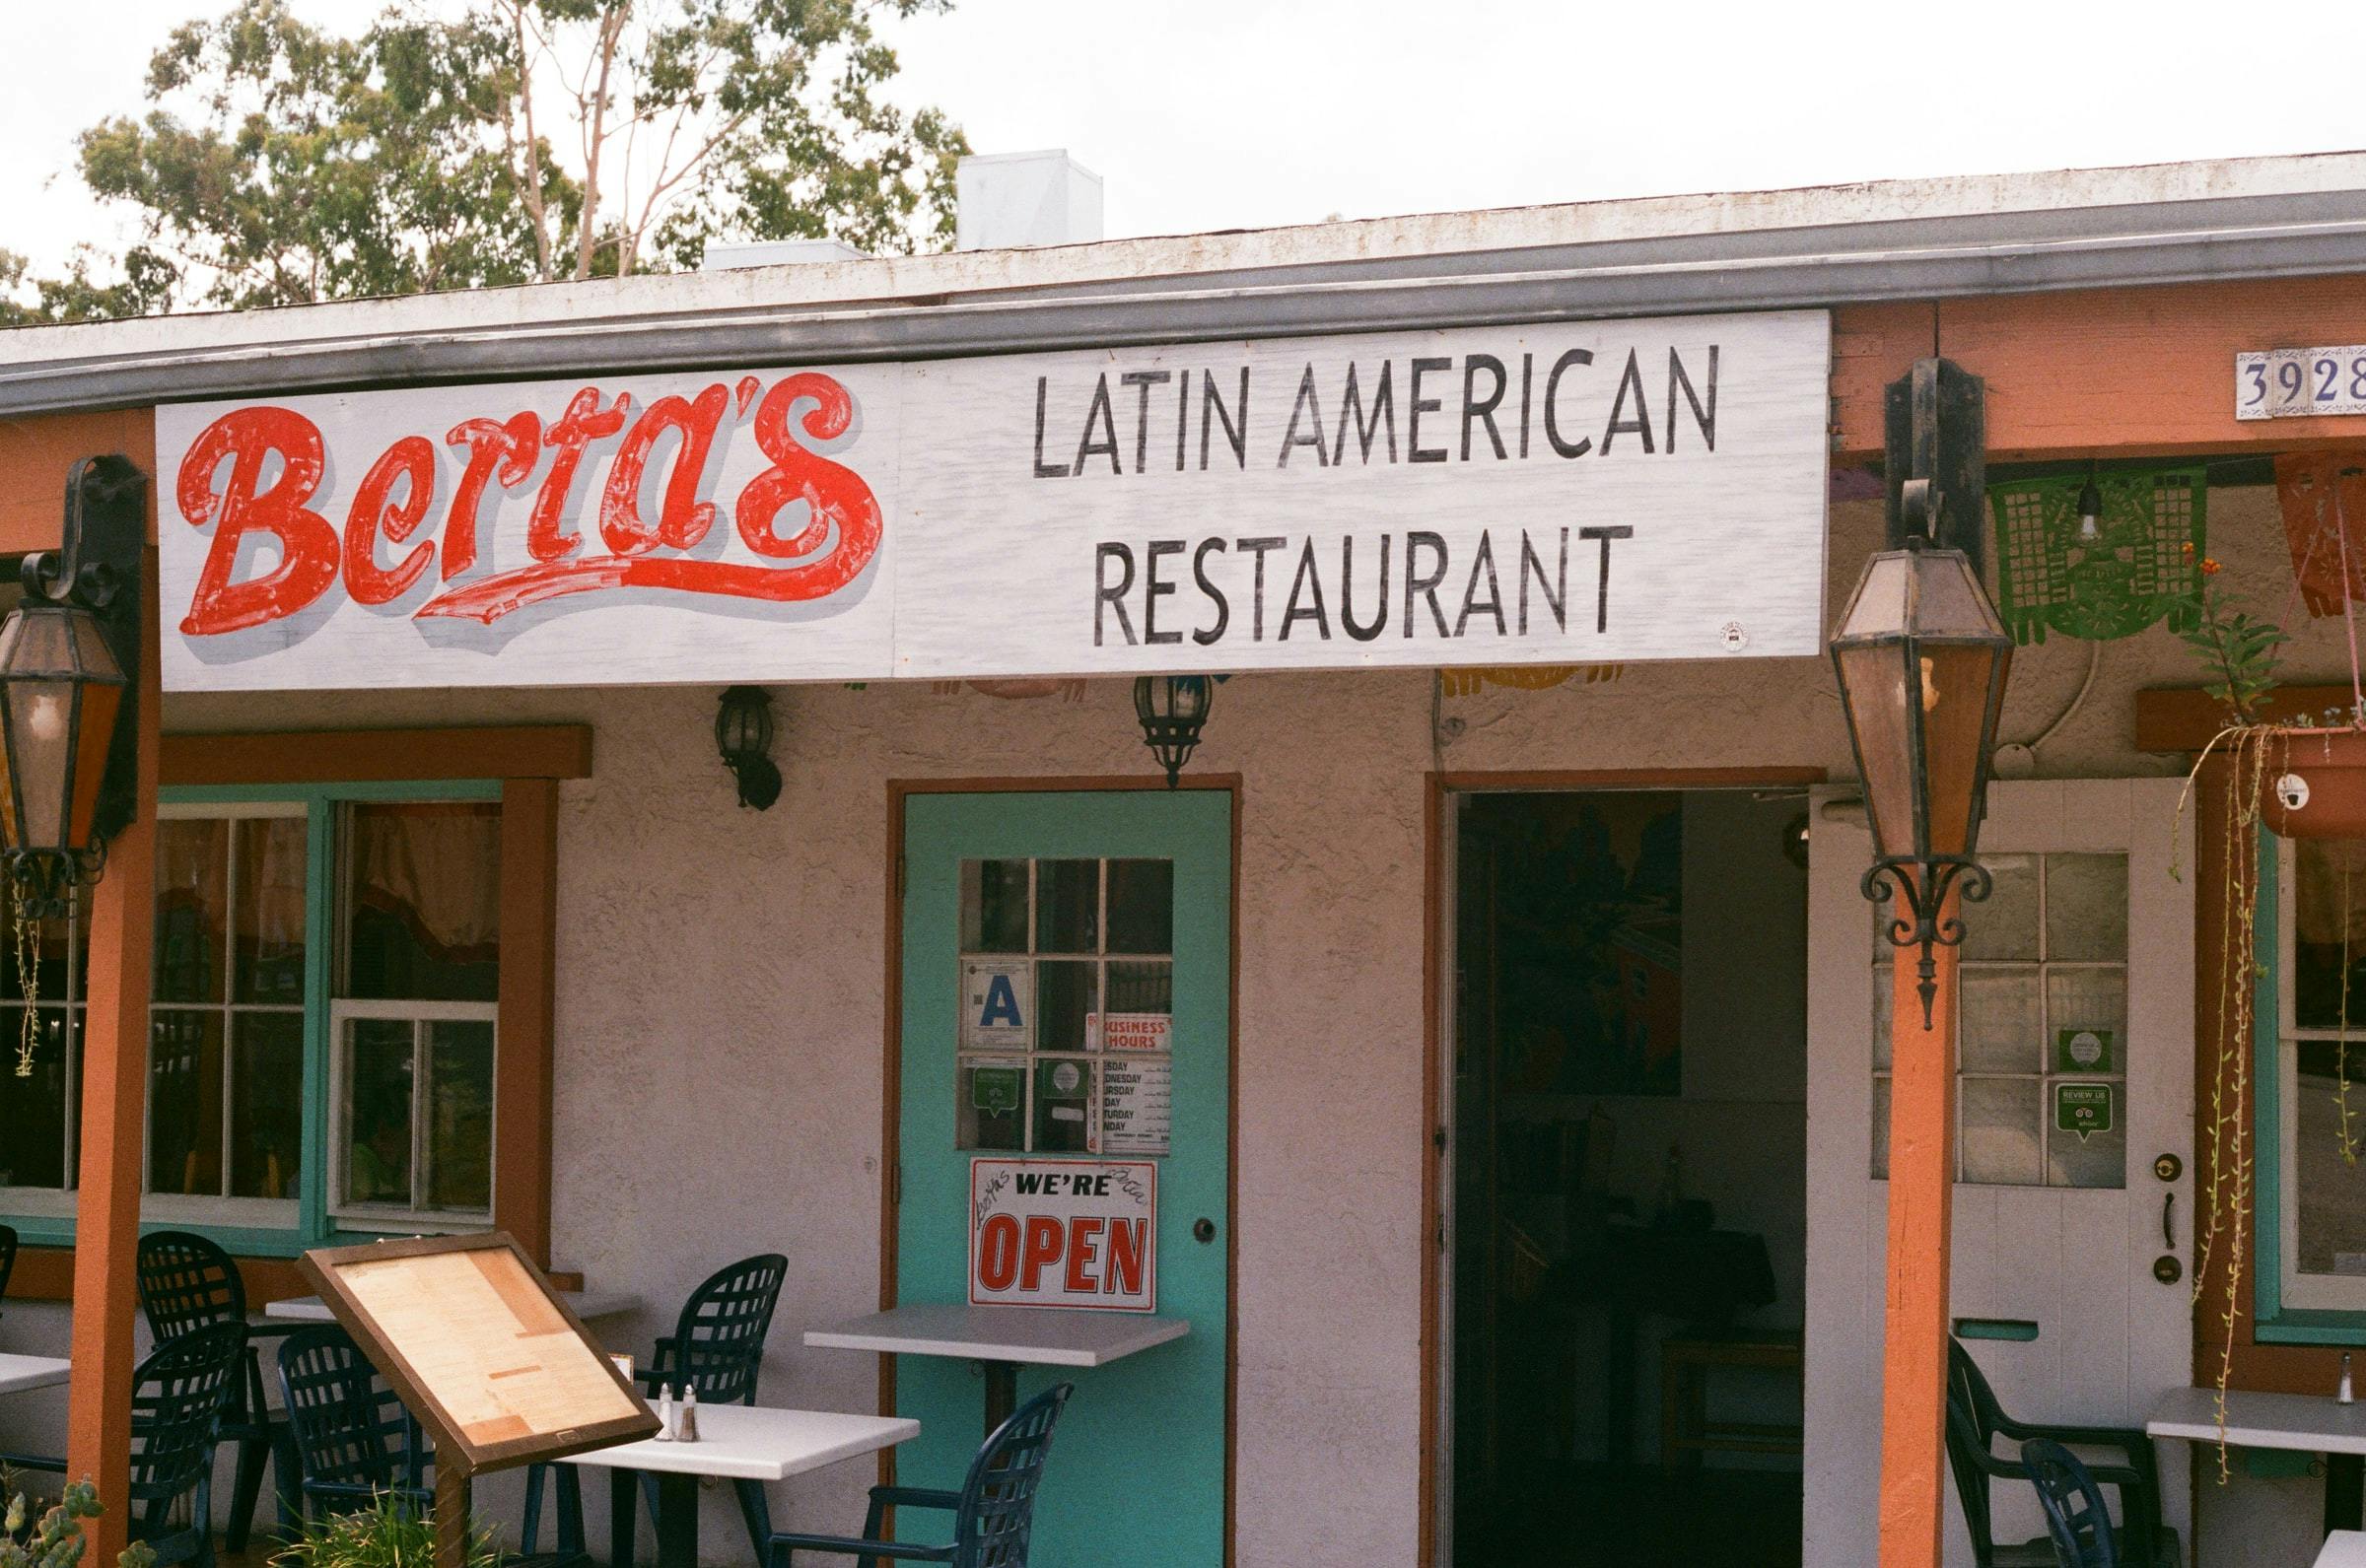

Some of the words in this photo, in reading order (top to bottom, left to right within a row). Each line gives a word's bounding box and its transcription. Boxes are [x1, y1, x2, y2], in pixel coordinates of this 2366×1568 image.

[1033, 366, 1249, 478] LATIN
[1277, 344, 1719, 468] AMERICAN
[2244, 356, 2366, 406] 3928
[177, 372, 884, 637] Berta's
[1094, 524, 1634, 647] RESTAURANT
[980, 975, 1023, 1027] A
[1109, 1036, 1155, 1048] HOURS
[1015, 1174, 1113, 1196] WE'RE
[978, 1213, 1147, 1295] OPEN
